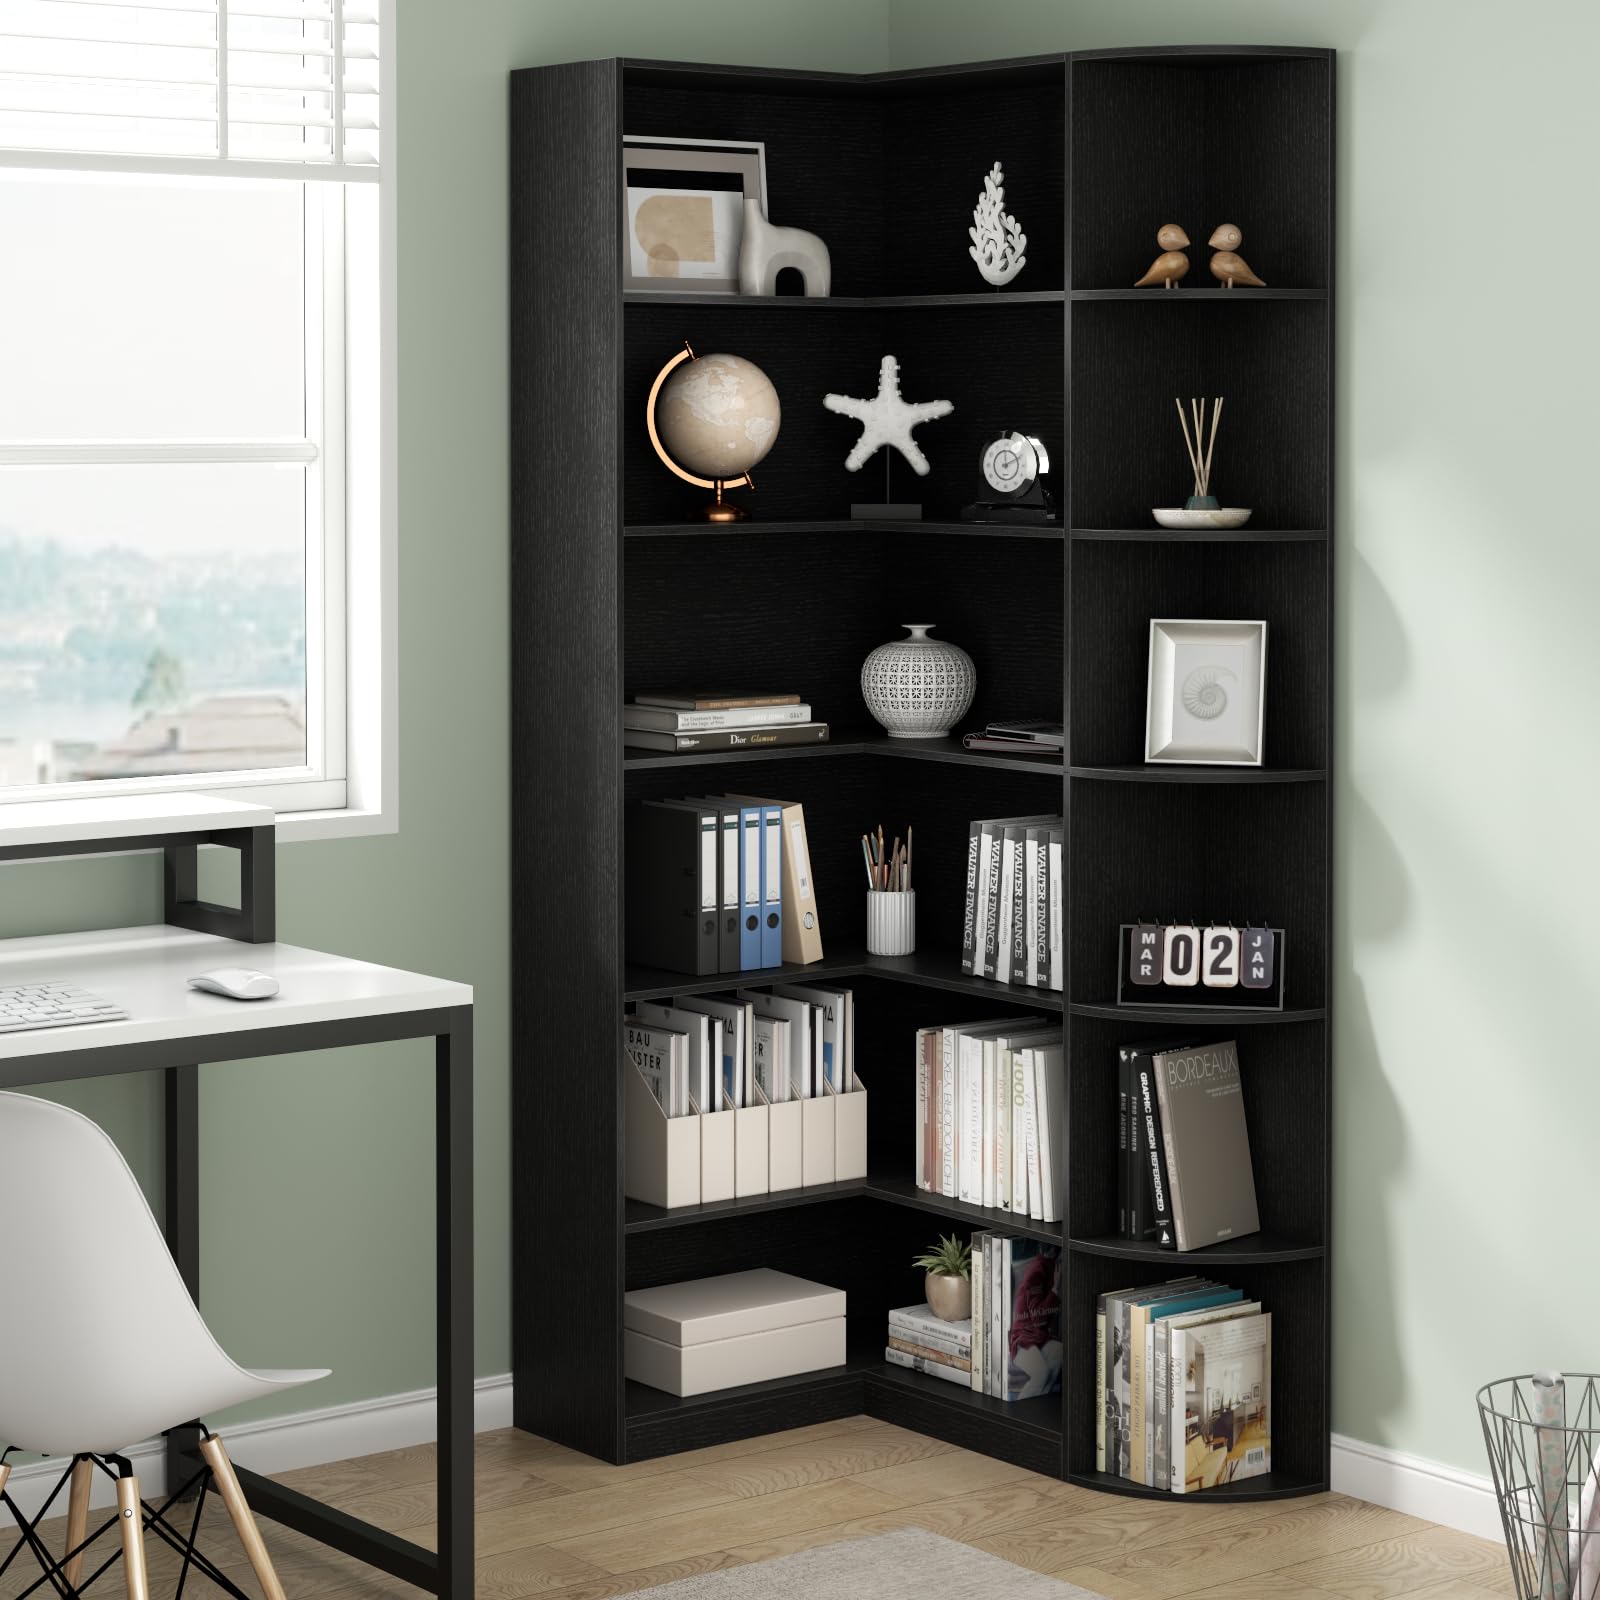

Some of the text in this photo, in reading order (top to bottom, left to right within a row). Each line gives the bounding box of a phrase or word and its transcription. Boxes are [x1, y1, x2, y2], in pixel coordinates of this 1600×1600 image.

[730, 734, 778, 744] Dior Glamour
[963, 836, 979, 950] WALTER FINANCE
[985, 840, 1001, 955] WALTER FINANCE
[1014, 842, 1023, 959] WALTER FINANCE
[1037, 845, 1046, 963] WALTER FINANCE
[1140, 932, 1156, 976] MAR
[1251, 935, 1265, 979] JAN
[628, 1049, 661, 1071] ISTER
[629, 1030, 650, 1047] BAU
[1167, 1047, 1237, 1085] BORDEAUX
[1140, 1072, 1153, 1114] GRAPHIC
[1145, 1115, 1158, 1151] DESIGN
[1149, 1151, 1165, 1213] REFERENCED
